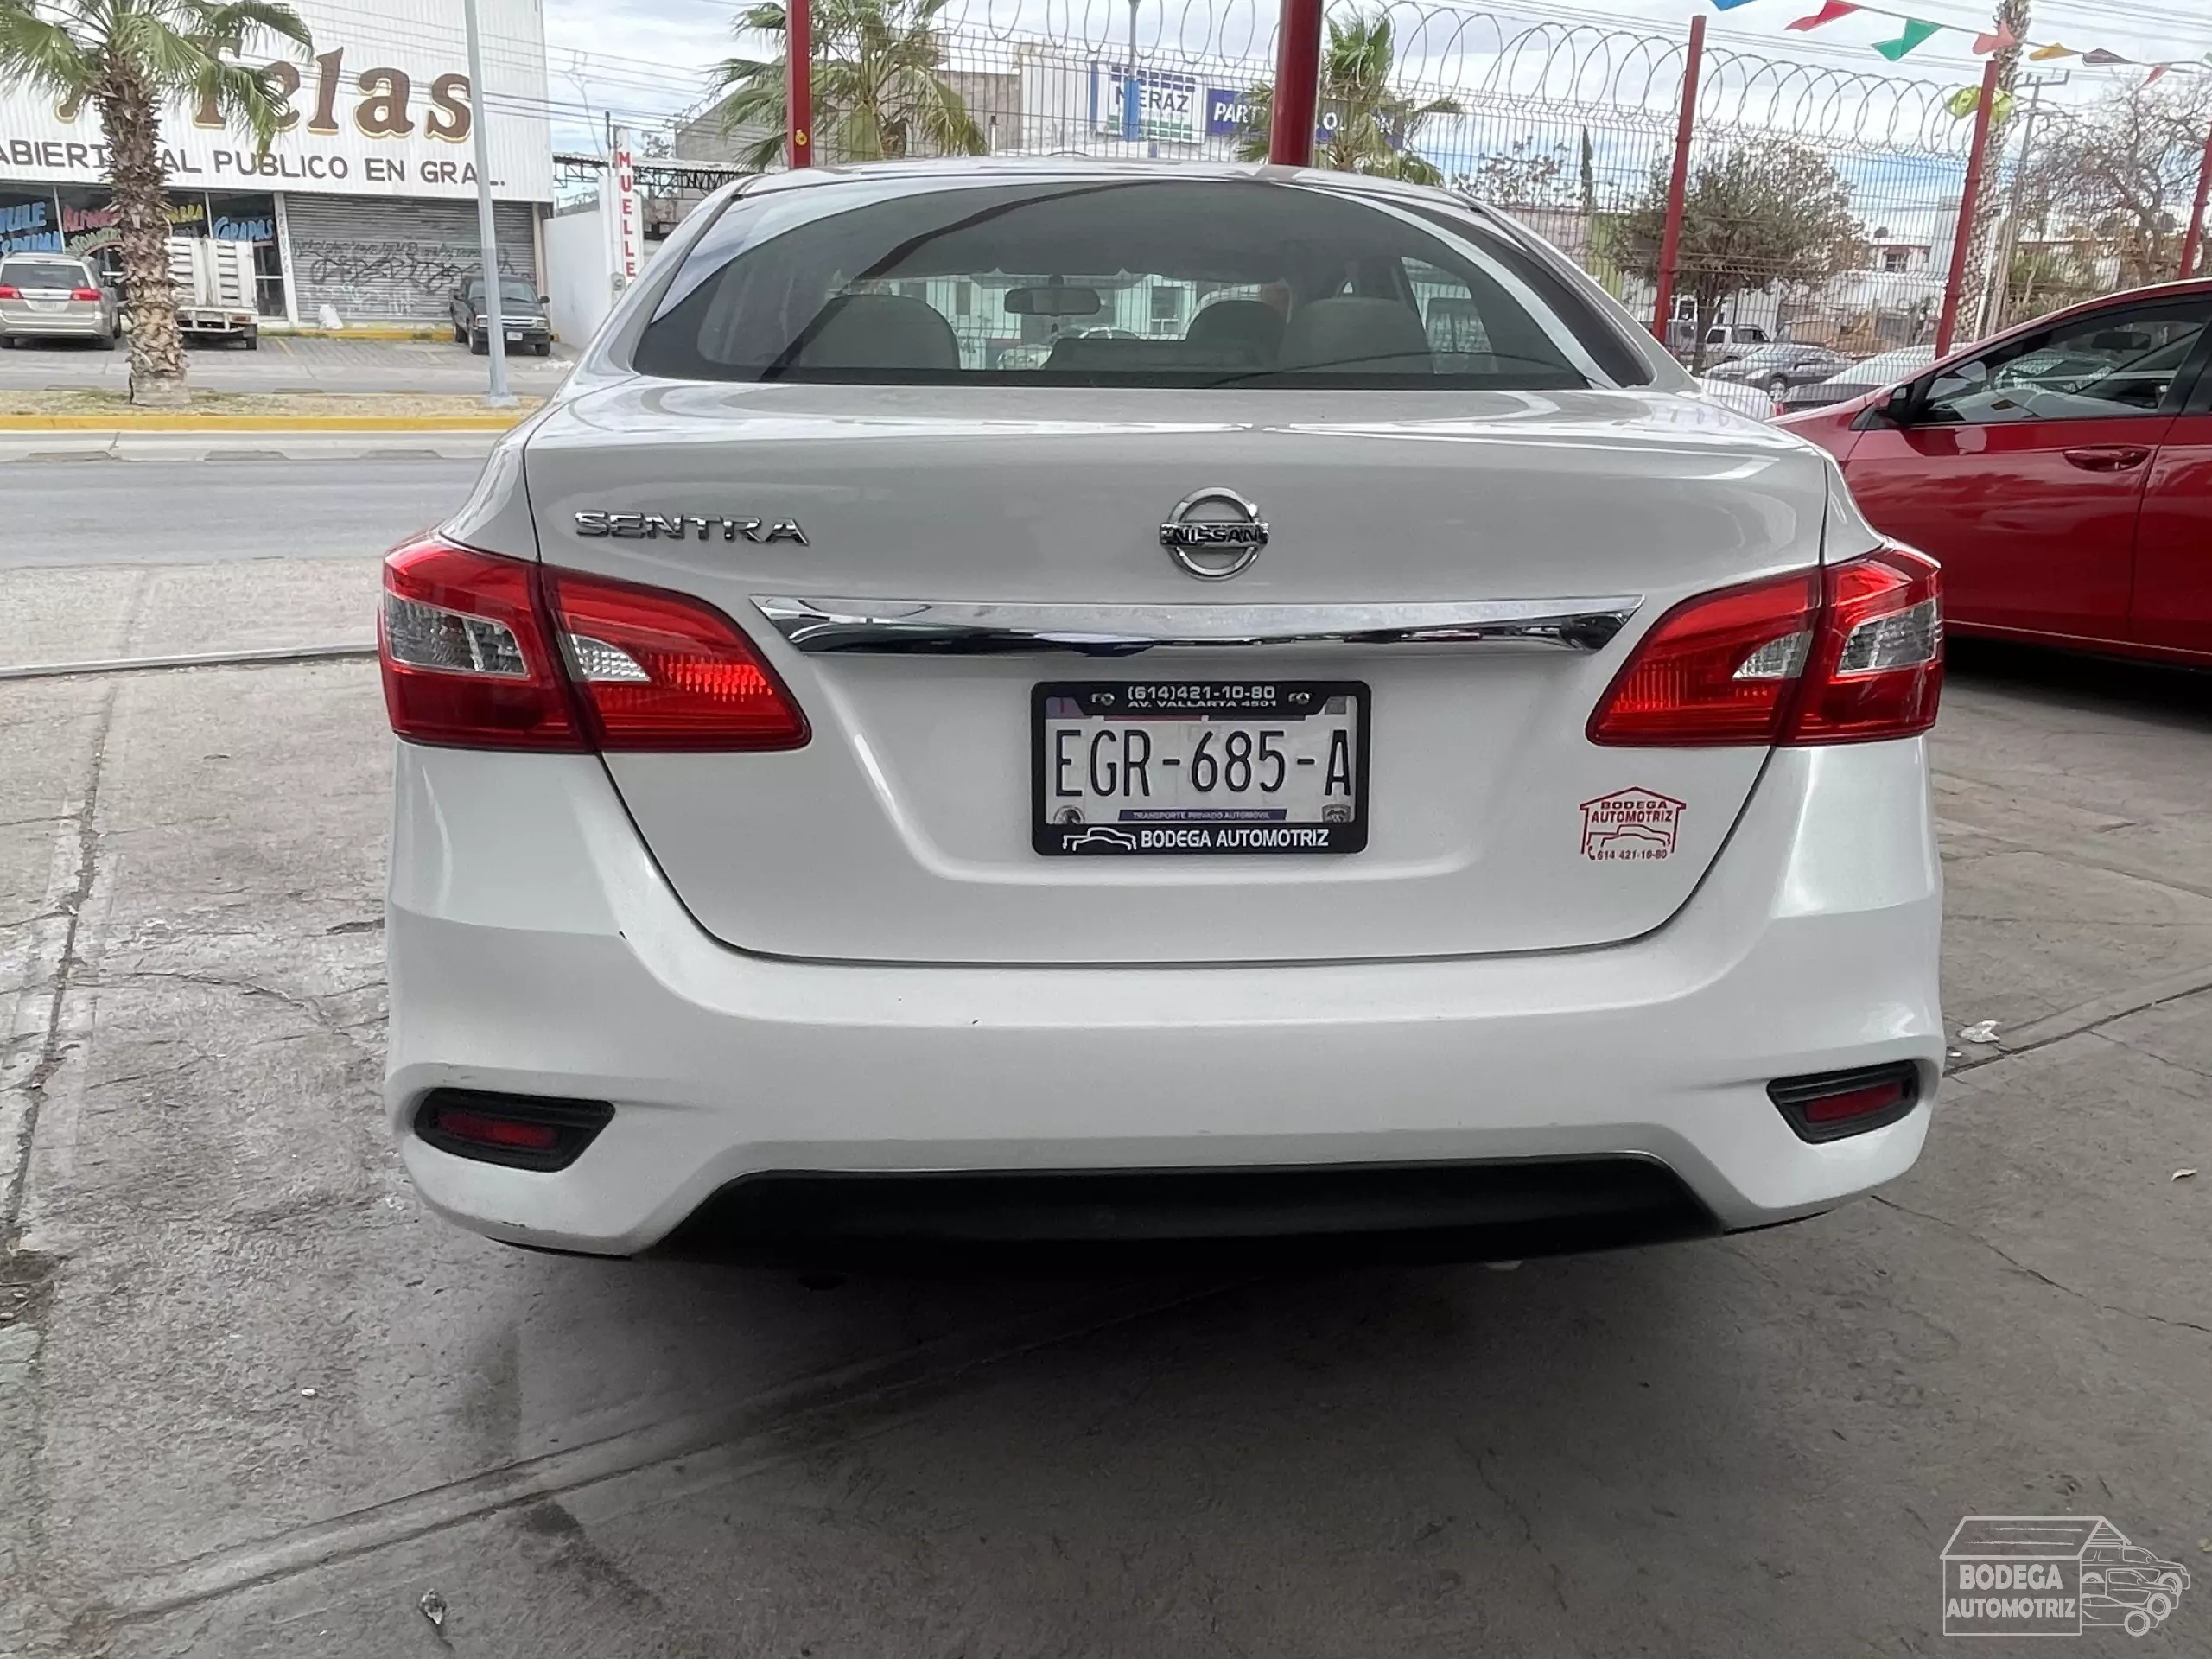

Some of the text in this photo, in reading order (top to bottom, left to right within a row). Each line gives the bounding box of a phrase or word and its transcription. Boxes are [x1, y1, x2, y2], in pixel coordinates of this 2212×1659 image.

[0, 139, 112, 169] ABIERT
[161, 149, 202, 173] AL
[213, 150, 348, 178] PUBLICO
[365, 158, 406, 181] EN
[617, 151, 636, 276] MUELLE
[575, 510, 810, 547] SENTRA
[1172, 527, 1257, 543] NISSAN
[1128, 685, 1275, 700] (614)421-10-80
[1055, 729, 1351, 797] EGR-685-A
[1600, 801, 1668, 810] BODEGA
[1133, 811, 1185, 820] TRANSPORTE
[1591, 810, 1673, 823] AUTOMOTRIZ
[1141, 829, 1329, 849] BODEGA AUTOMOTRIZ
[1597, 849, 1668, 861] 614 421-10-80
